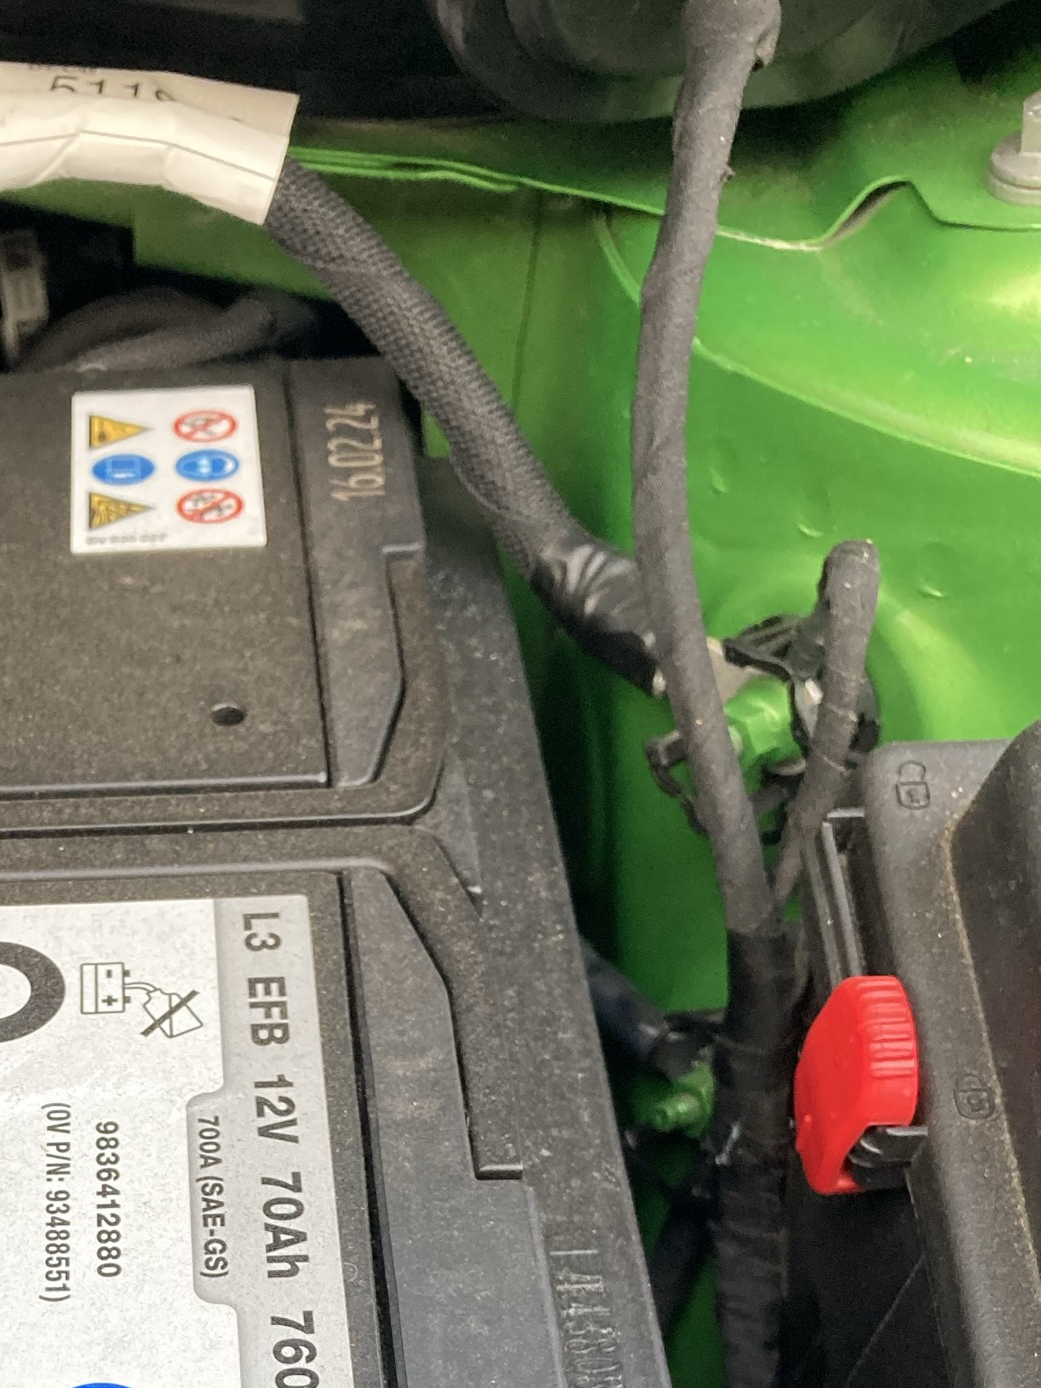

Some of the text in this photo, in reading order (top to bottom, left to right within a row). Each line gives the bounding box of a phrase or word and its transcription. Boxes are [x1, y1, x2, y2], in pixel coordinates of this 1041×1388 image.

[242, 912, 281, 952] L3
[247, 976, 290, 1046] EFB
[253, 1074, 300, 1144] 12V
[45, 1141, 71, 1182] P/N:
[95, 1120, 122, 1278] 9836412880
[195, 1115, 230, 1278] 700A (SAE-GS)
[38, 1189, 71, 1302] 93488551)
[260, 1171, 309, 1279] 70Ah
